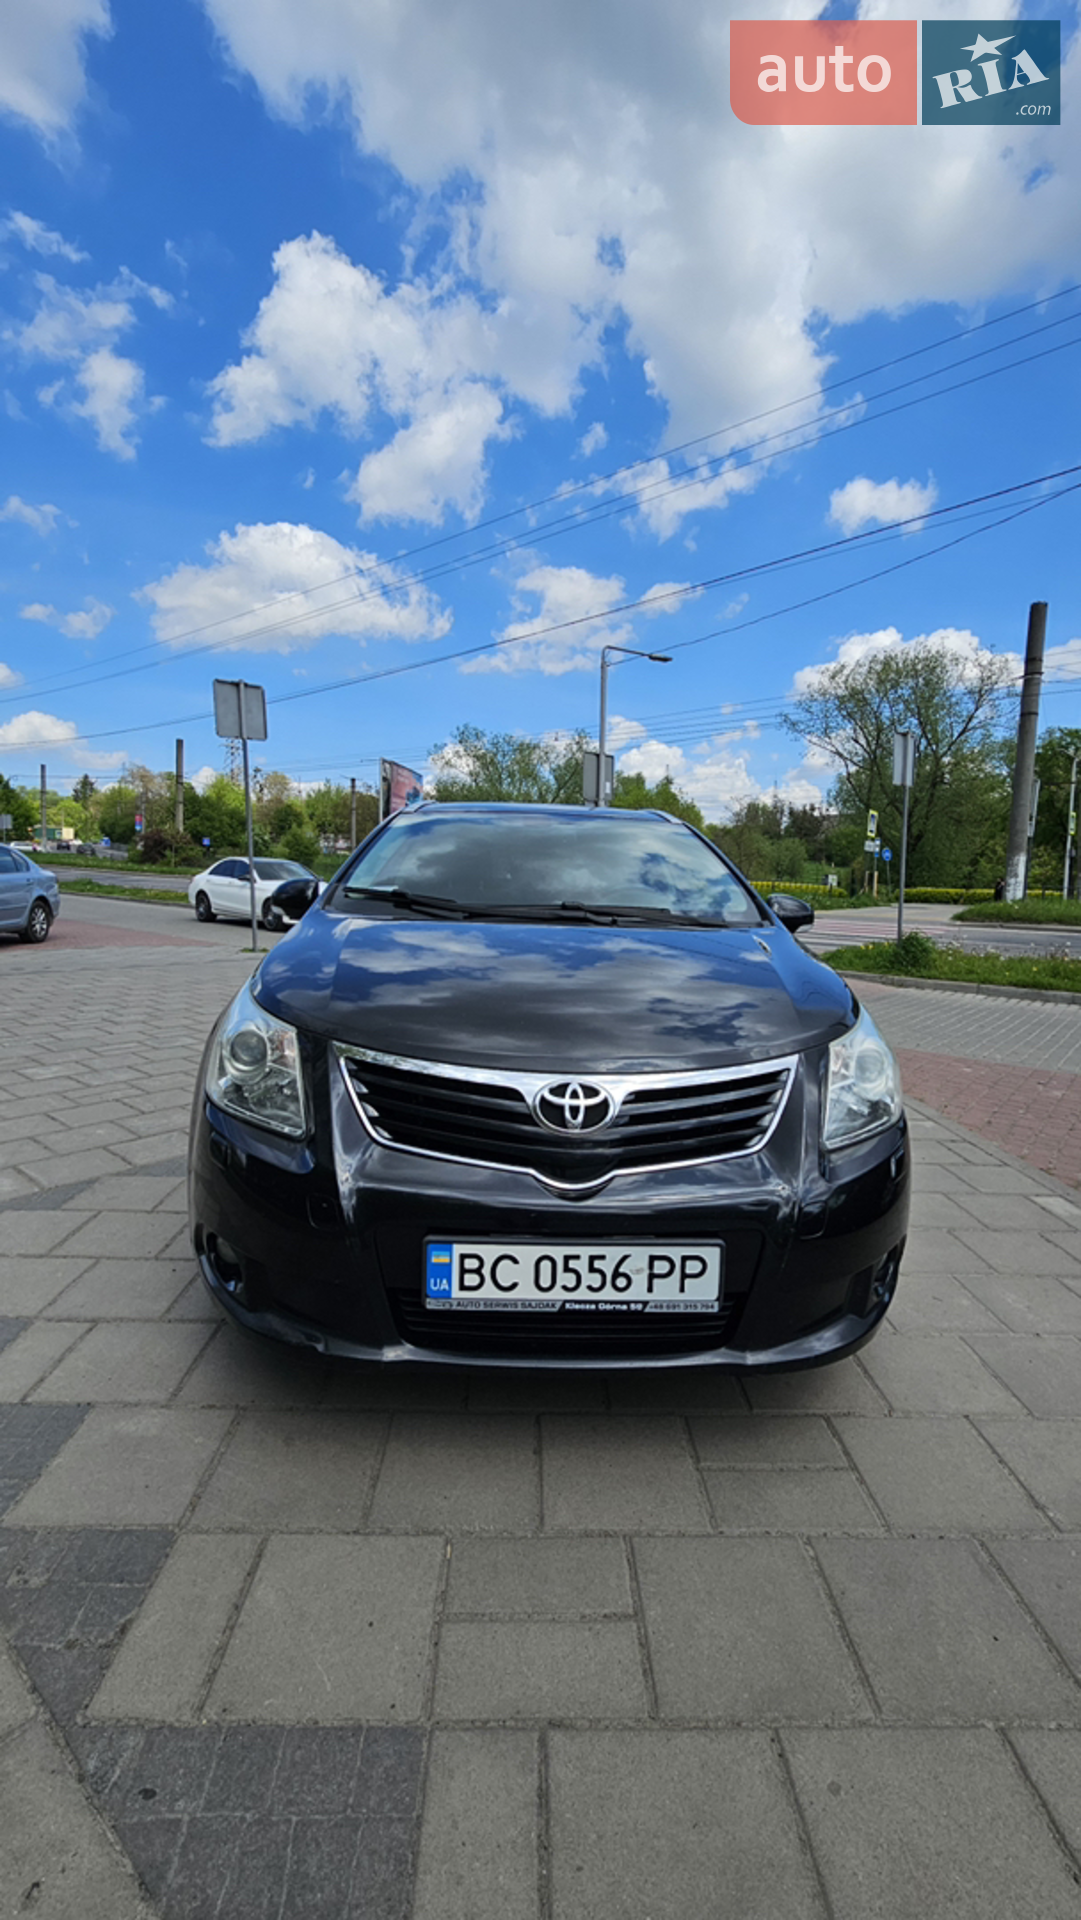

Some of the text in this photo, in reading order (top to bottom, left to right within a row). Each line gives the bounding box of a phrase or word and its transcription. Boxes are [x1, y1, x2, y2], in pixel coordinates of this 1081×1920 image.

[458, 1252, 708, 1294] BC 0556 PP
[430, 1278, 449, 1291] UA
[455, 1300, 481, 1309] AUTO
[483, 1301, 518, 1309] SERWIS
